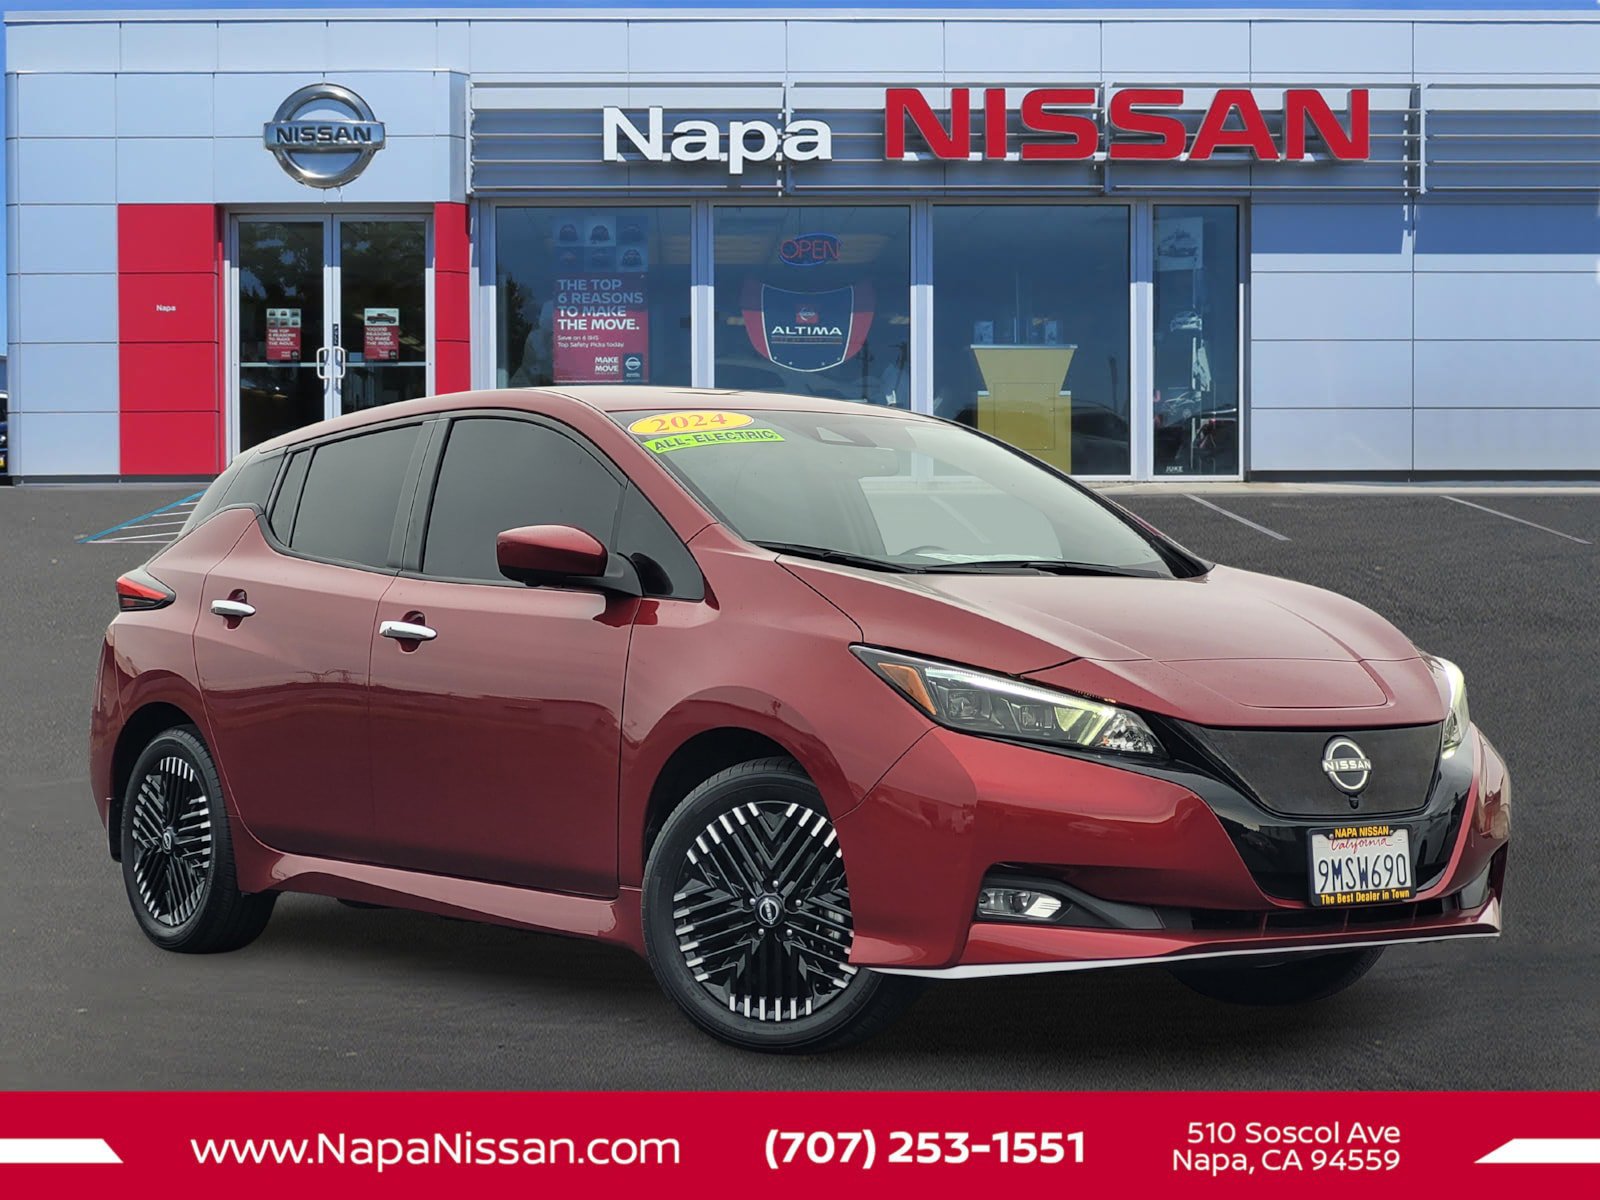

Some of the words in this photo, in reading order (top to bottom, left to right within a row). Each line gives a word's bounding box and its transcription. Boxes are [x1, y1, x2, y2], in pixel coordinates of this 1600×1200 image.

[276, 126, 372, 143] NISSAN
[602, 105, 833, 175] Napa
[886, 88, 1369, 161] NISSAN
[780, 239, 841, 261] OPEN
[557, 279, 587, 291] THE
[590, 279, 622, 291] TOP
[558, 292, 567, 304] 6
[571, 292, 644, 304] REASONS
[156, 304, 177, 313] Napa
[557, 305, 578, 317] TO
[582, 305, 627, 317] MAKE
[557, 319, 587, 331] THE
[591, 319, 640, 331] MOVE.
[771, 326, 842, 335] ALTIMA
[595, 356, 619, 364] MAKE
[595, 365, 619, 373] MOVE
[651, 413, 728, 432] 2024
[655, 429, 777, 451] ALL-ELECTRIC
[1324, 760, 1371, 772] NISSAN
[1334, 827, 1357, 838] NAPA
[1359, 825, 1389, 837] NISSAN
[1330, 838, 1393, 854] California
[1318, 853, 1407, 892] 9MSW690
[1321, 894, 1335, 905] The
[1337, 893, 1354, 903] Best
[1356, 891, 1380, 902] Dealer
[1382, 890, 1389, 899] in
[1391, 888, 1410, 899] Town
